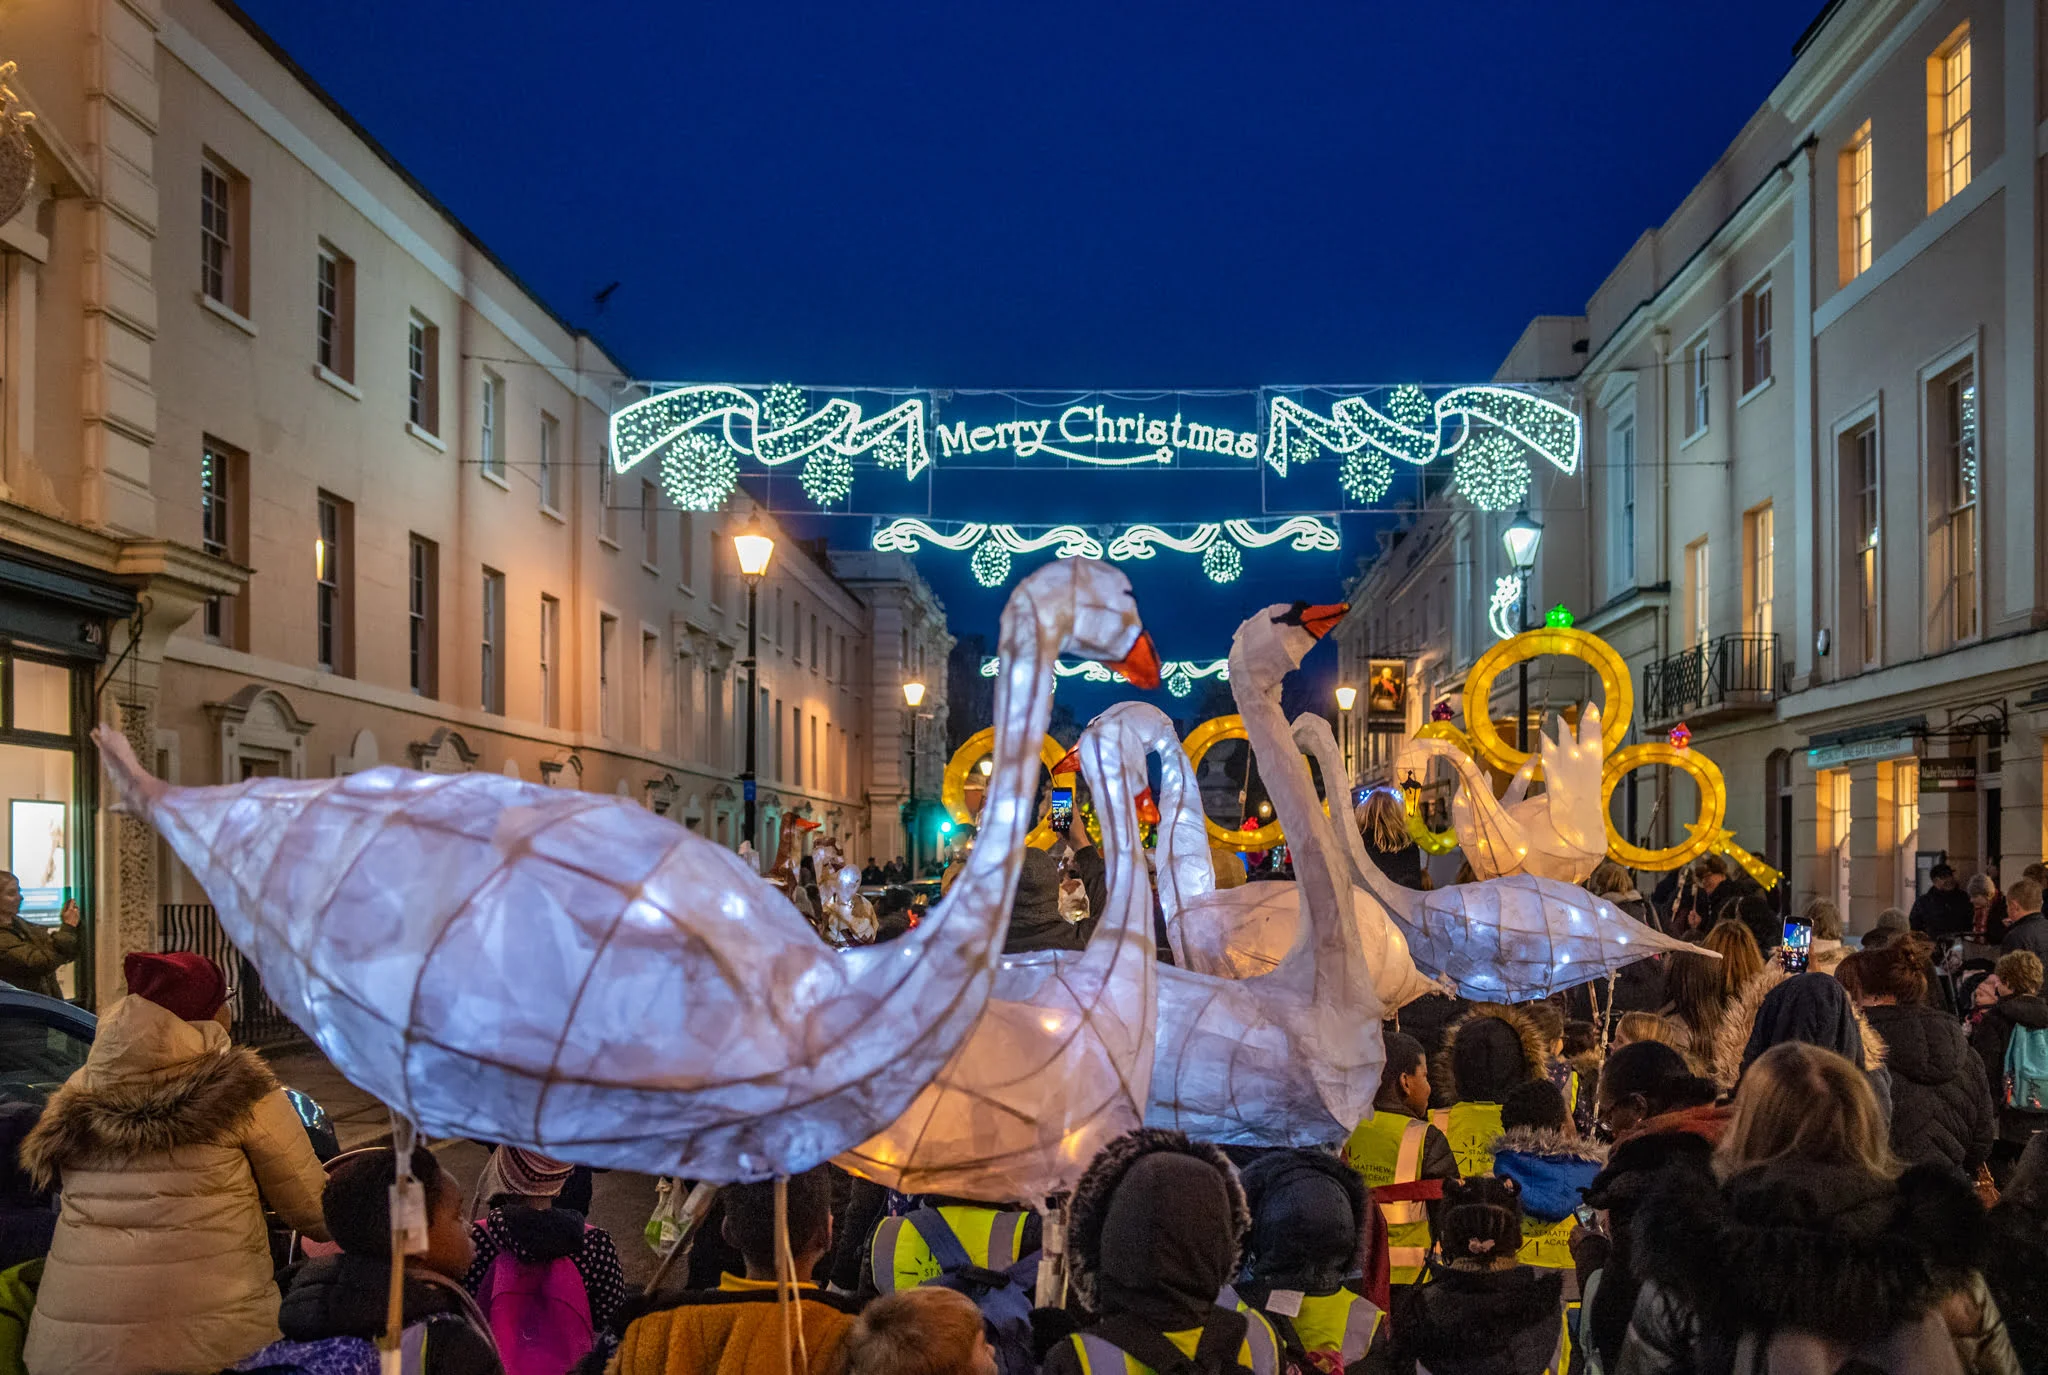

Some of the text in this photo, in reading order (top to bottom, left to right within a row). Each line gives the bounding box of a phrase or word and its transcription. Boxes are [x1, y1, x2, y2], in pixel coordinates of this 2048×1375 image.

[936, 404, 1258, 458] Merry Christmas
[85, 623, 102, 644] 20
[1353, 1163, 1391, 1173] MATTHEW
[1545, 1230, 1571, 1238] MATTH
[1544, 1238, 1568, 1247] ACAD
